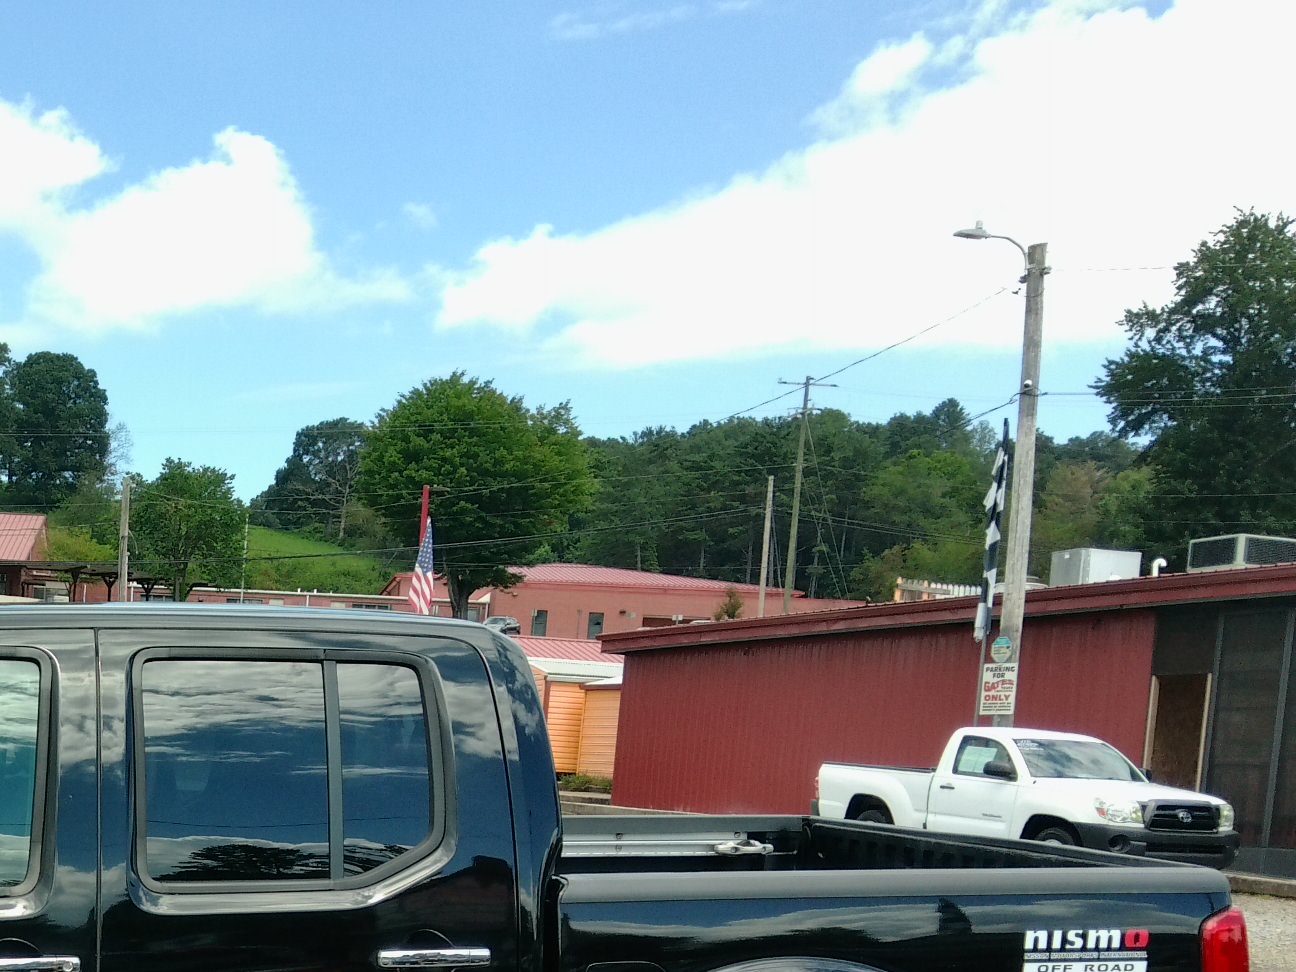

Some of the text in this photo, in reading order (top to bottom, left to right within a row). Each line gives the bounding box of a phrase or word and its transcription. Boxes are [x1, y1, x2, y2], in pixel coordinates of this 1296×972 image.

[984, 694, 1011, 702] ONLY
[1024, 928, 1150, 950] nismo
[1084, 963, 1135, 972] ROAD
